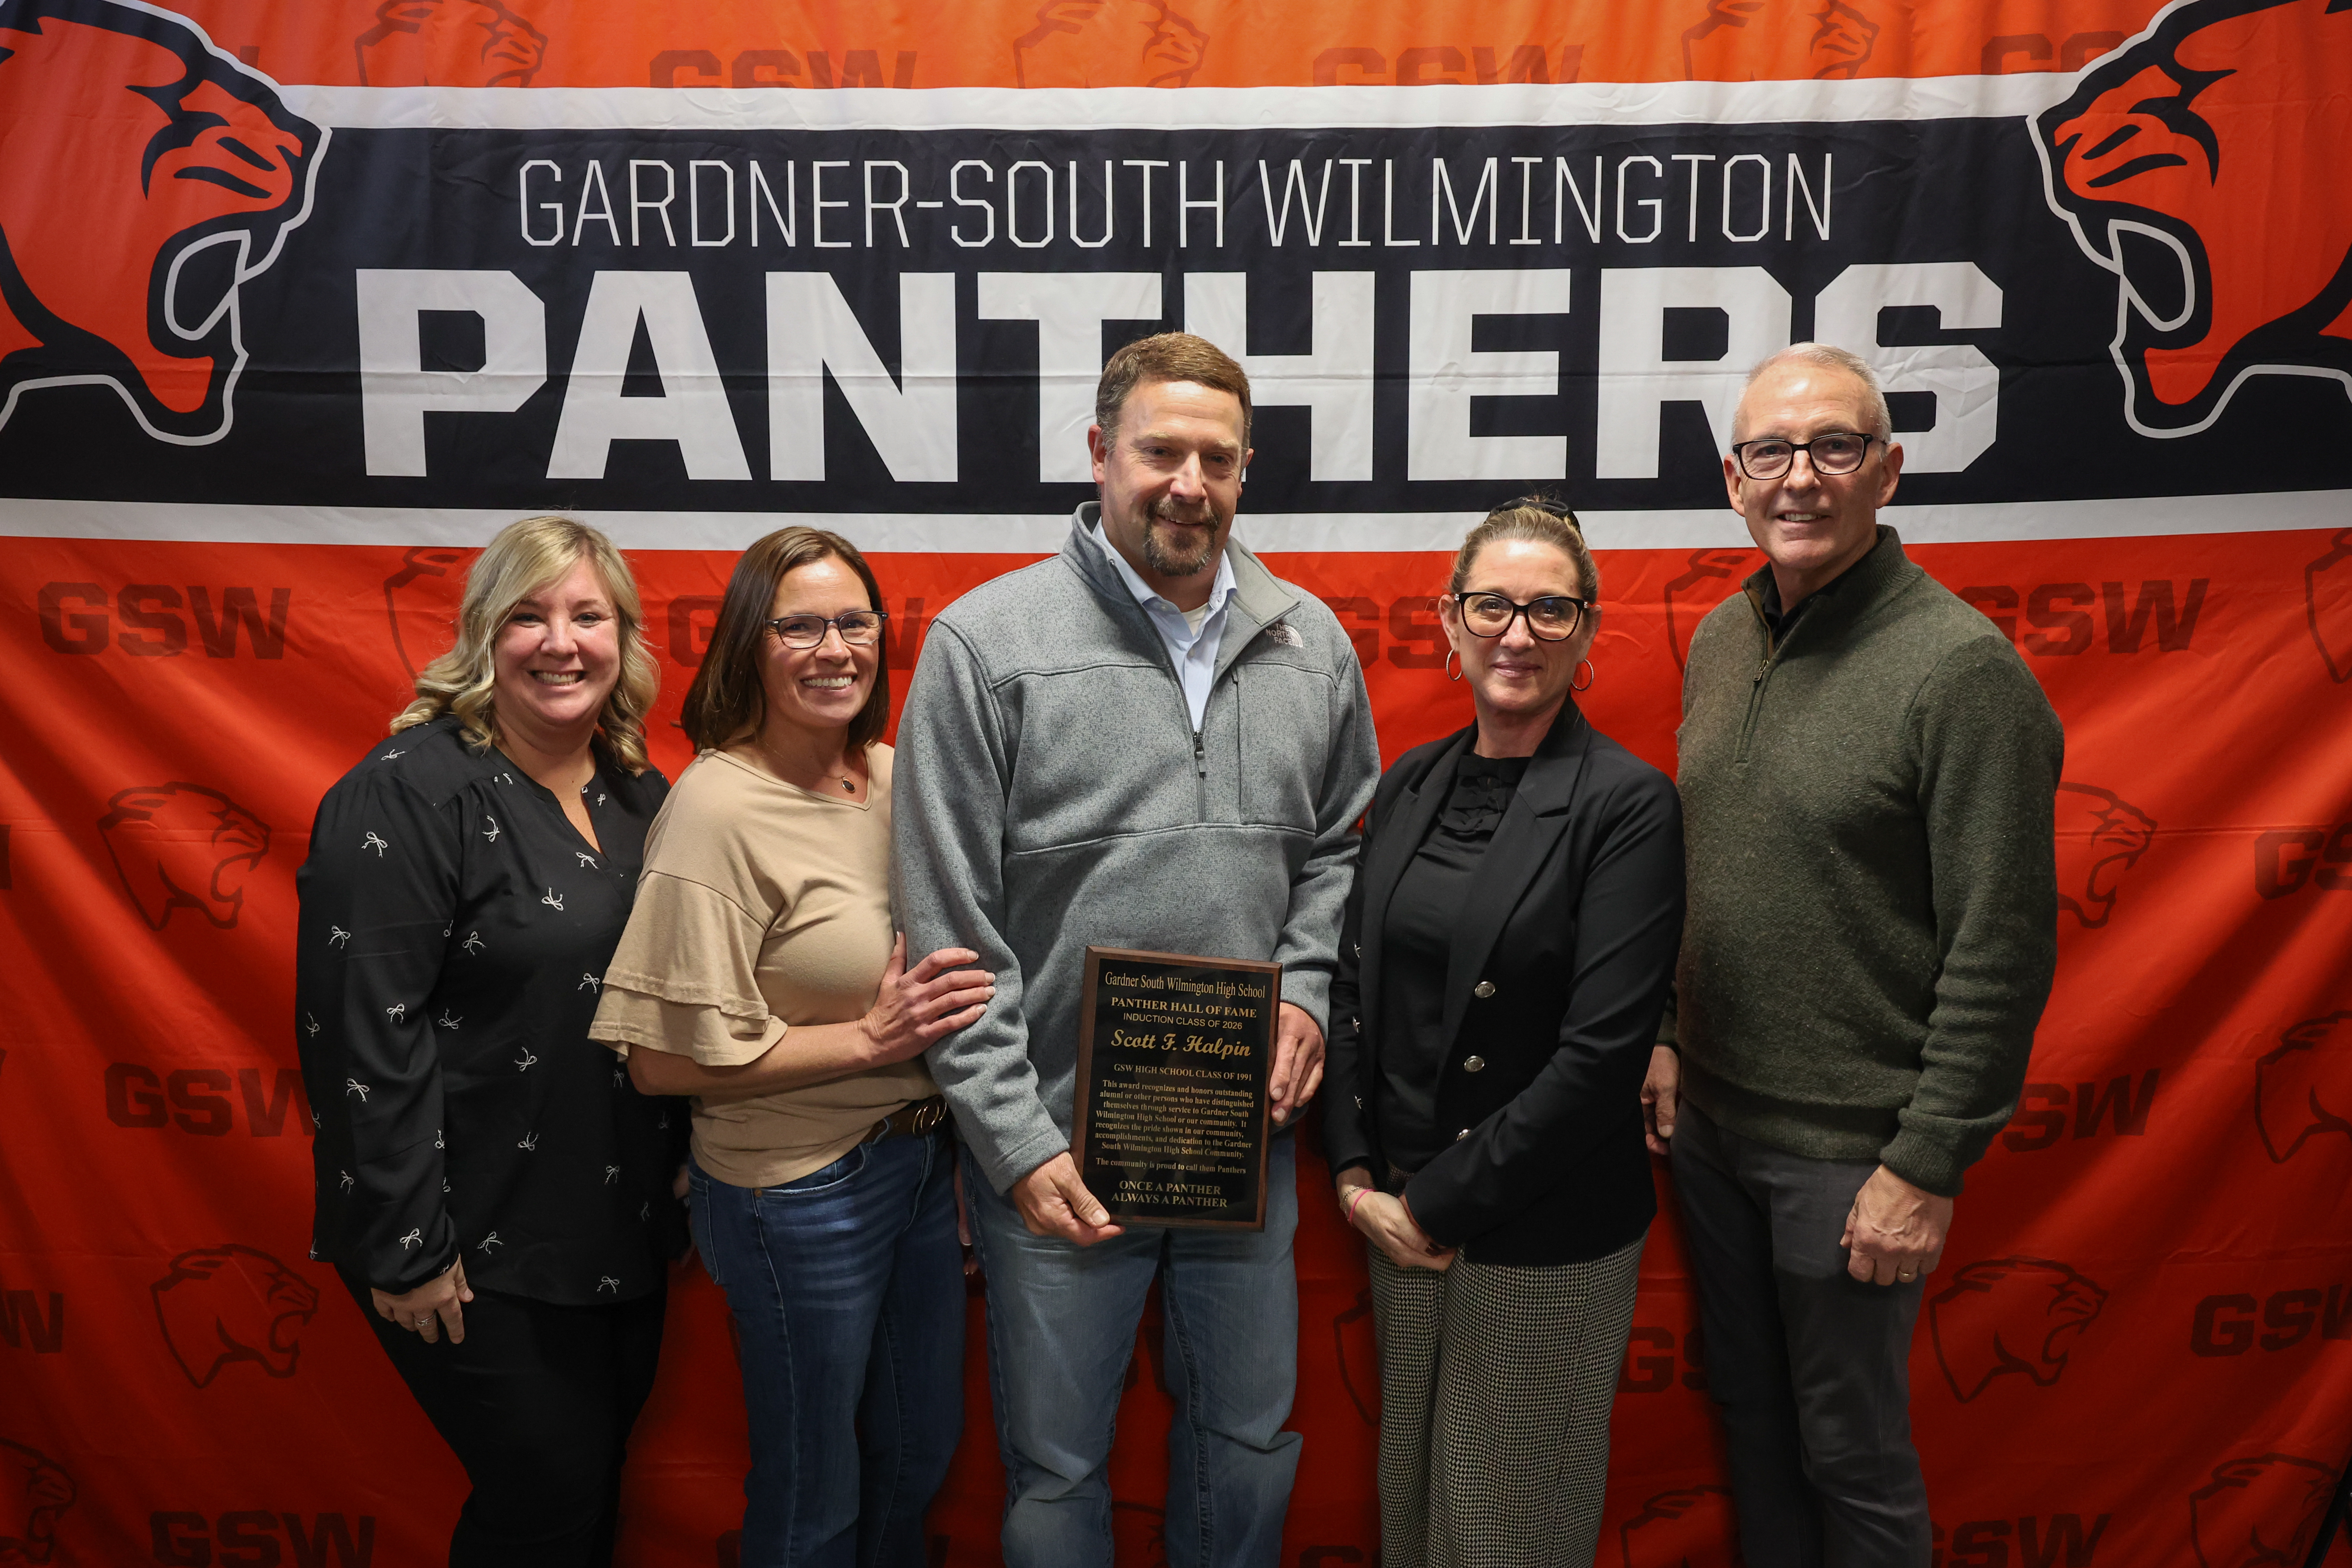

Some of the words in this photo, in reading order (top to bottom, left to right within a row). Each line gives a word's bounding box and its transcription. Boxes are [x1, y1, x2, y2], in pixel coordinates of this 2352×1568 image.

[519, 158, 1224, 249] GARDNER-SOUTH
[1258, 152, 1833, 247] WILMINGTON
[356, 261, 2004, 484] PANTHERS
[37, 581, 292, 660] GSW
[1275, 623, 1289, 632] THE
[1266, 629, 1291, 639] NORTH
[1274, 637, 1293, 645] FACE
[1321, 596, 1455, 669] GS
[1105, 971, 1139, 987] Gardner
[1140, 974, 1164, 989] South
[1167, 977, 1214, 996] Wilmington
[1215, 981, 1236, 999] High
[1238, 983, 1265, 999] School
[1111, 996, 1168, 1011] PANTHER
[1170, 1002, 1204, 1014] HALL
[1205, 1005, 1223, 1015] OF
[1223, 1006, 1257, 1018] FAME
[1123, 1012, 1174, 1024] INDUCTION
[1176, 1017, 1206, 1027] CLASS
[1208, 1019, 1221, 1028] OF
[1222, 1021, 1243, 1030] 2026
[1110, 1029, 1156, 1050] Scott
[1160, 1033, 1177, 1051] F.
[1182, 1035, 1251, 1060] Halpin
[1113, 1063, 1134, 1072] GSW
[1135, 1065, 1157, 1074] HIGH
[1159, 1067, 1195, 1077] SCHOOL
[1195, 1069, 1222, 1079] CLASS
[1223, 1072, 1235, 1080] OF
[1236, 1073, 1252, 1081] 1991
[1102, 1079, 1117, 1088] This
[1141, 1084, 1176, 1092] recognizes
[1191, 1086, 1214, 1095] honors
[1214, 1089, 1253, 1098] outstanding
[104, 1062, 315, 1138] GSW
[1099, 1090, 1123, 1099] alumni
[1133, 1092, 1152, 1100] other
[1195, 1097, 1211, 1105] have
[1211, 1098, 1254, 1108] distinguished
[1103, 1100, 1139, 1110] themselves
[1141, 1103, 1167, 1113] through
[1200, 1107, 1229, 1116] Gardner
[1230, 1109, 1249, 1118] South
[2002, 1068, 2161, 1153] SW
[1096, 1110, 1135, 1121] Wilmington
[1137, 1113, 1153, 1122] High
[1154, 1114, 1176, 1123] School
[1199, 1119, 1237, 1129] community.
[1241, 1120, 1247, 1128] It
[1094, 1132, 1153, 1142] accomplishments,
[1169, 1136, 1203, 1145] dedication
[1224, 1139, 1252, 1148] Gardner
[1095, 1122, 1130, 1130] recognizes
[1131, 1123, 1142, 1131] the
[1143, 1124, 1161, 1133] pride
[1162, 1125, 1183, 1134] shown
[1185, 1126, 1192, 1135] in
[1205, 1130, 1244, 1139] community,
[1101, 1141, 1121, 1150] South
[1123, 1143, 1162, 1154] Wilmington
[1163, 1145, 1180, 1155] High
[1181, 1147, 1203, 1155] School
[1204, 1148, 1244, 1160] Community.
[1095, 1157, 1110, 1166] The
[1110, 1160, 1148, 1170] community
[1156, 1162, 1176, 1171] proud
[1199, 1164, 1216, 1172] them
[1217, 1165, 1246, 1174] Panthers
[1119, 1180, 1153, 1191] ONCE
[1155, 1182, 1163, 1192] A
[1166, 1183, 1221, 1195] PANTHER
[1111, 1192, 1159, 1204] ALWAYS
[1161, 1195, 1170, 1204] A
[1172, 1195, 1227, 1208] PANTHER
[149, 1511, 376, 1568] GSW
[1932, 1514, 2114, 1568] SW
